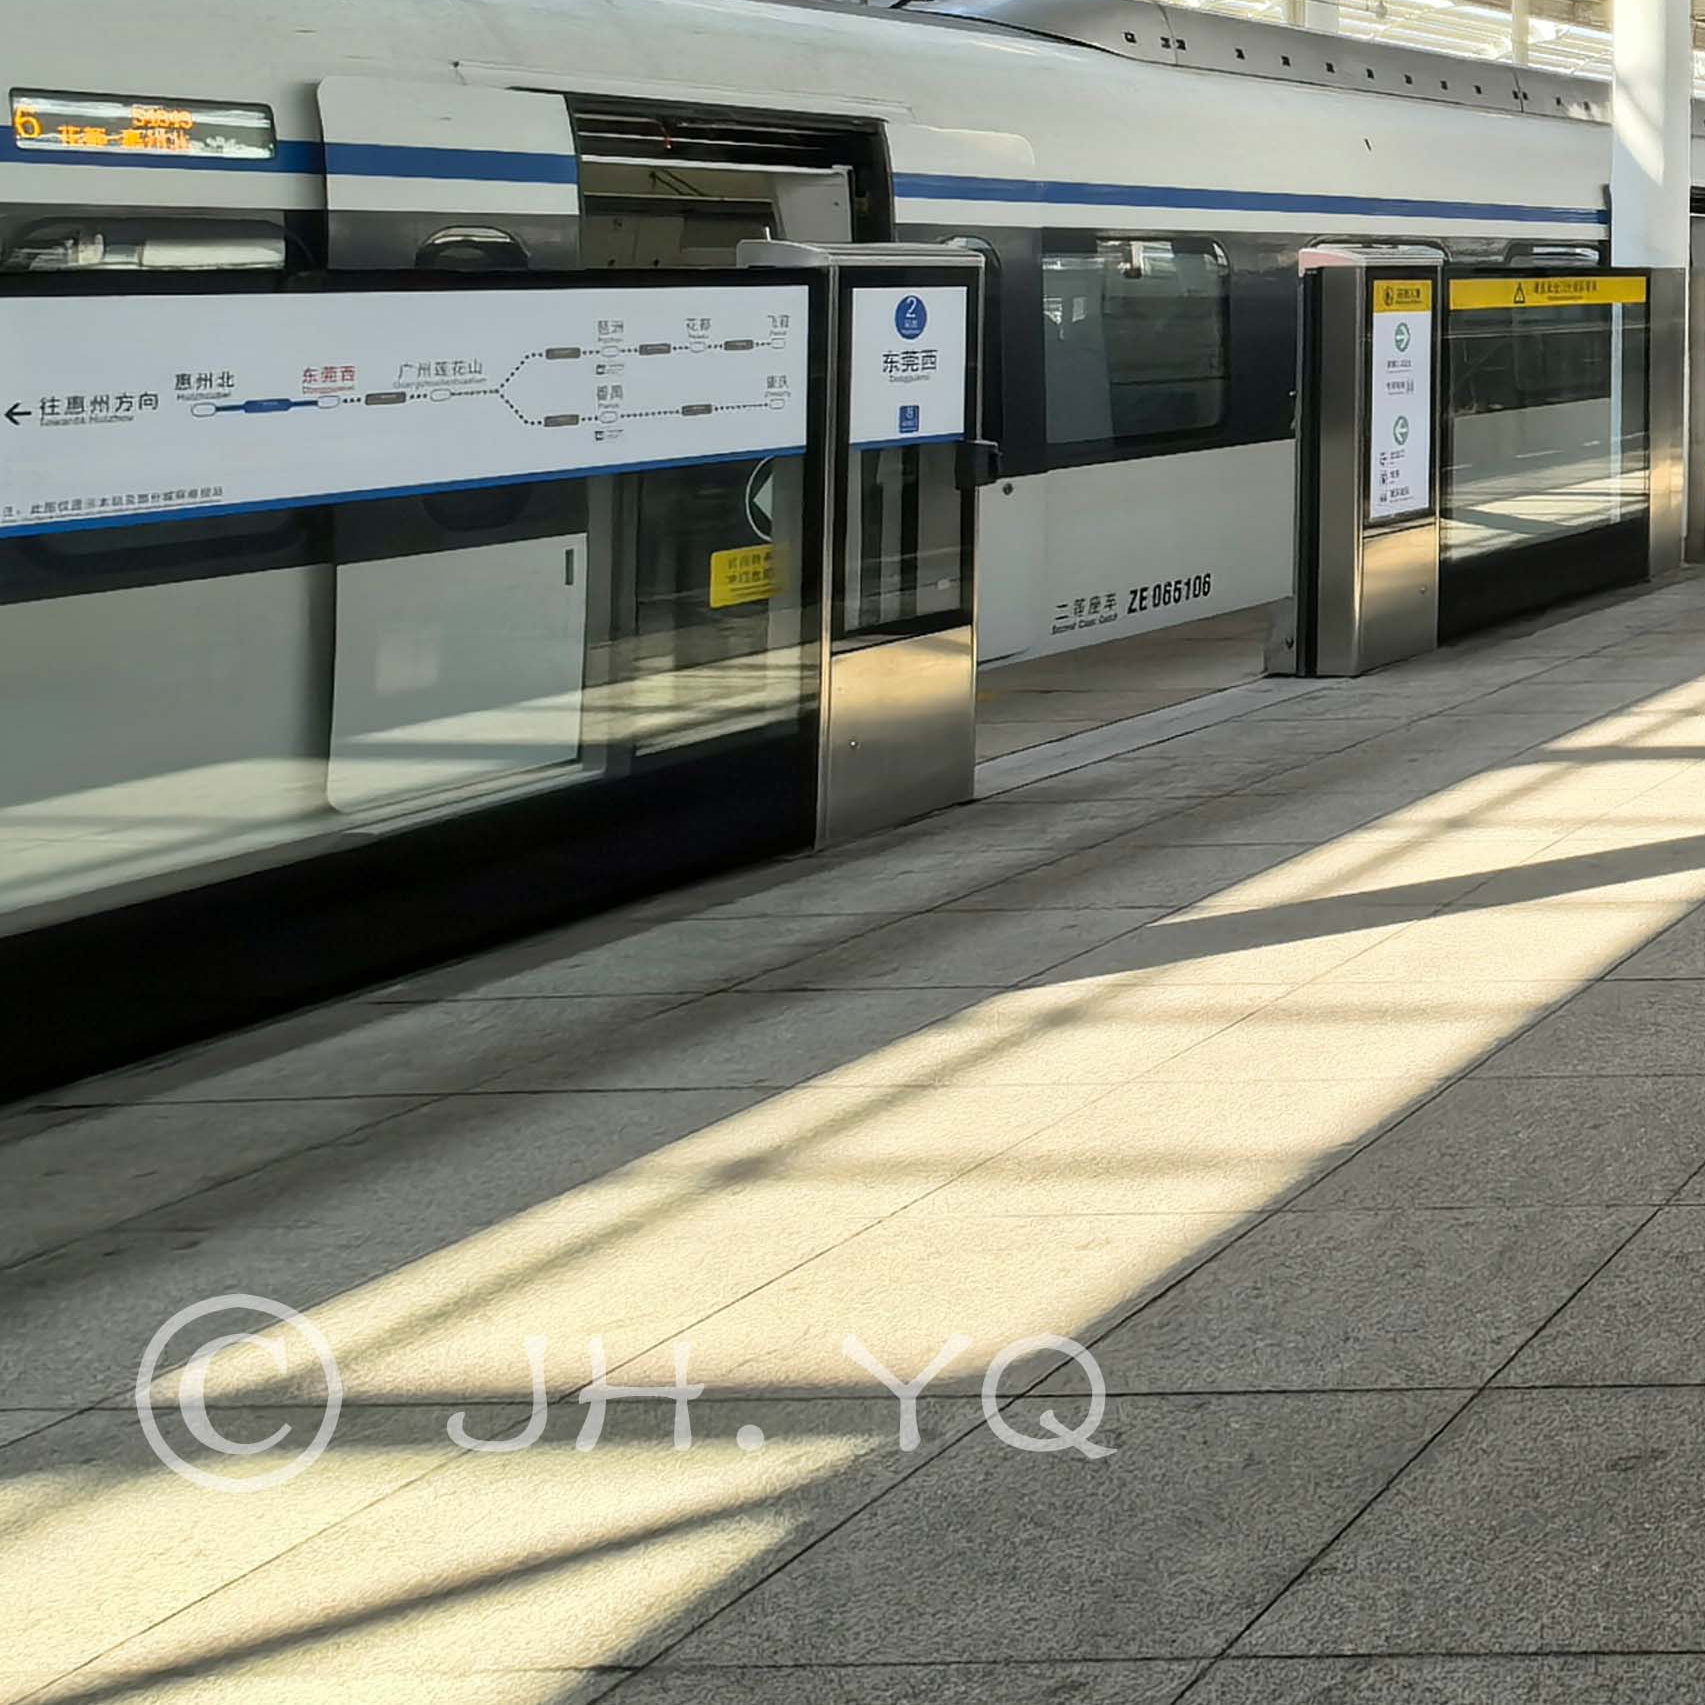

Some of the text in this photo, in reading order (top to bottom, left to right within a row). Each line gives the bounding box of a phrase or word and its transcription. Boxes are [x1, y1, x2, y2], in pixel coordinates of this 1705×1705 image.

[14, 107, 42, 138] 6
[906, 297, 917, 318] 2
[883, 350, 938, 374] 东莞西
[175, 371, 235, 391] 惠州北
[303, 366, 356, 383] 东莞西
[40, 392, 159, 417] 往惠州方向
[1055, 593, 1117, 620] 二等座车
[1127, 586, 1149, 614] ZE
